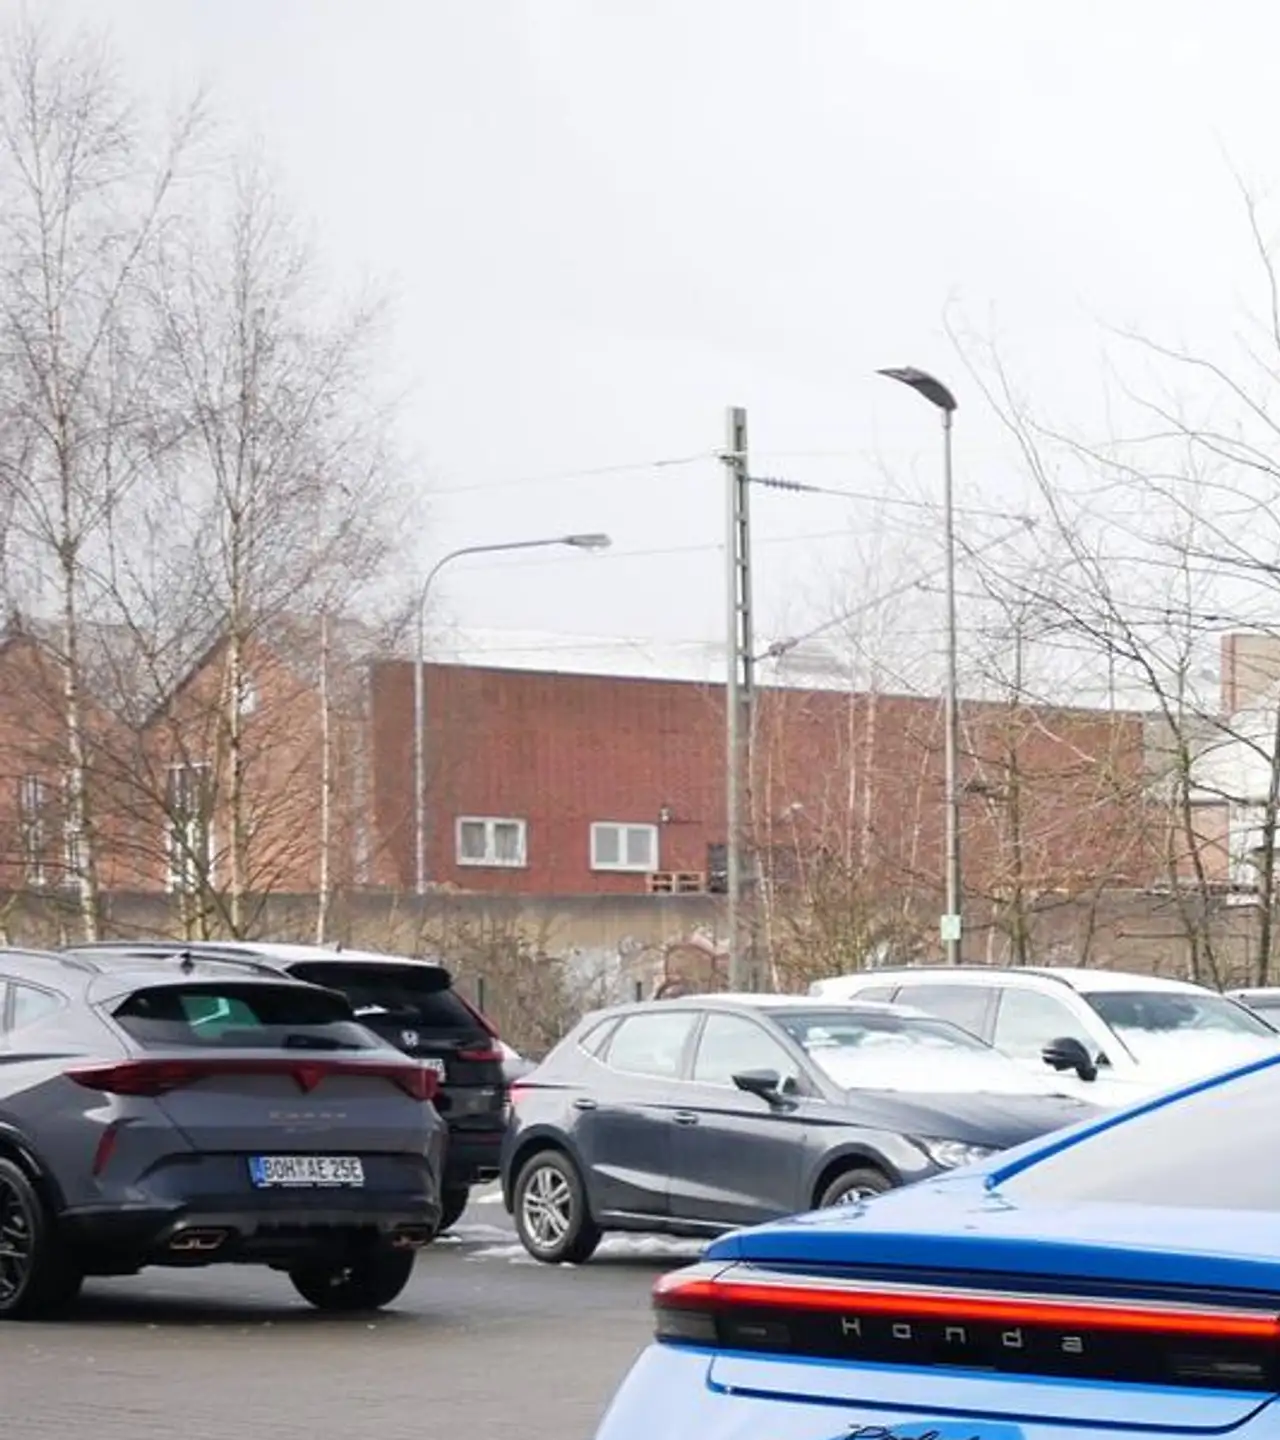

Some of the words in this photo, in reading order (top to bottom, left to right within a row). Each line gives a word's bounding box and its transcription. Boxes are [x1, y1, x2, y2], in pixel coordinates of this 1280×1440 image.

[264, 1158, 297, 1179] BOH
[308, 1158, 328, 1179] AE
[330, 1158, 361, 1179] 25E
[841, 1316, 1084, 1354] Honda
